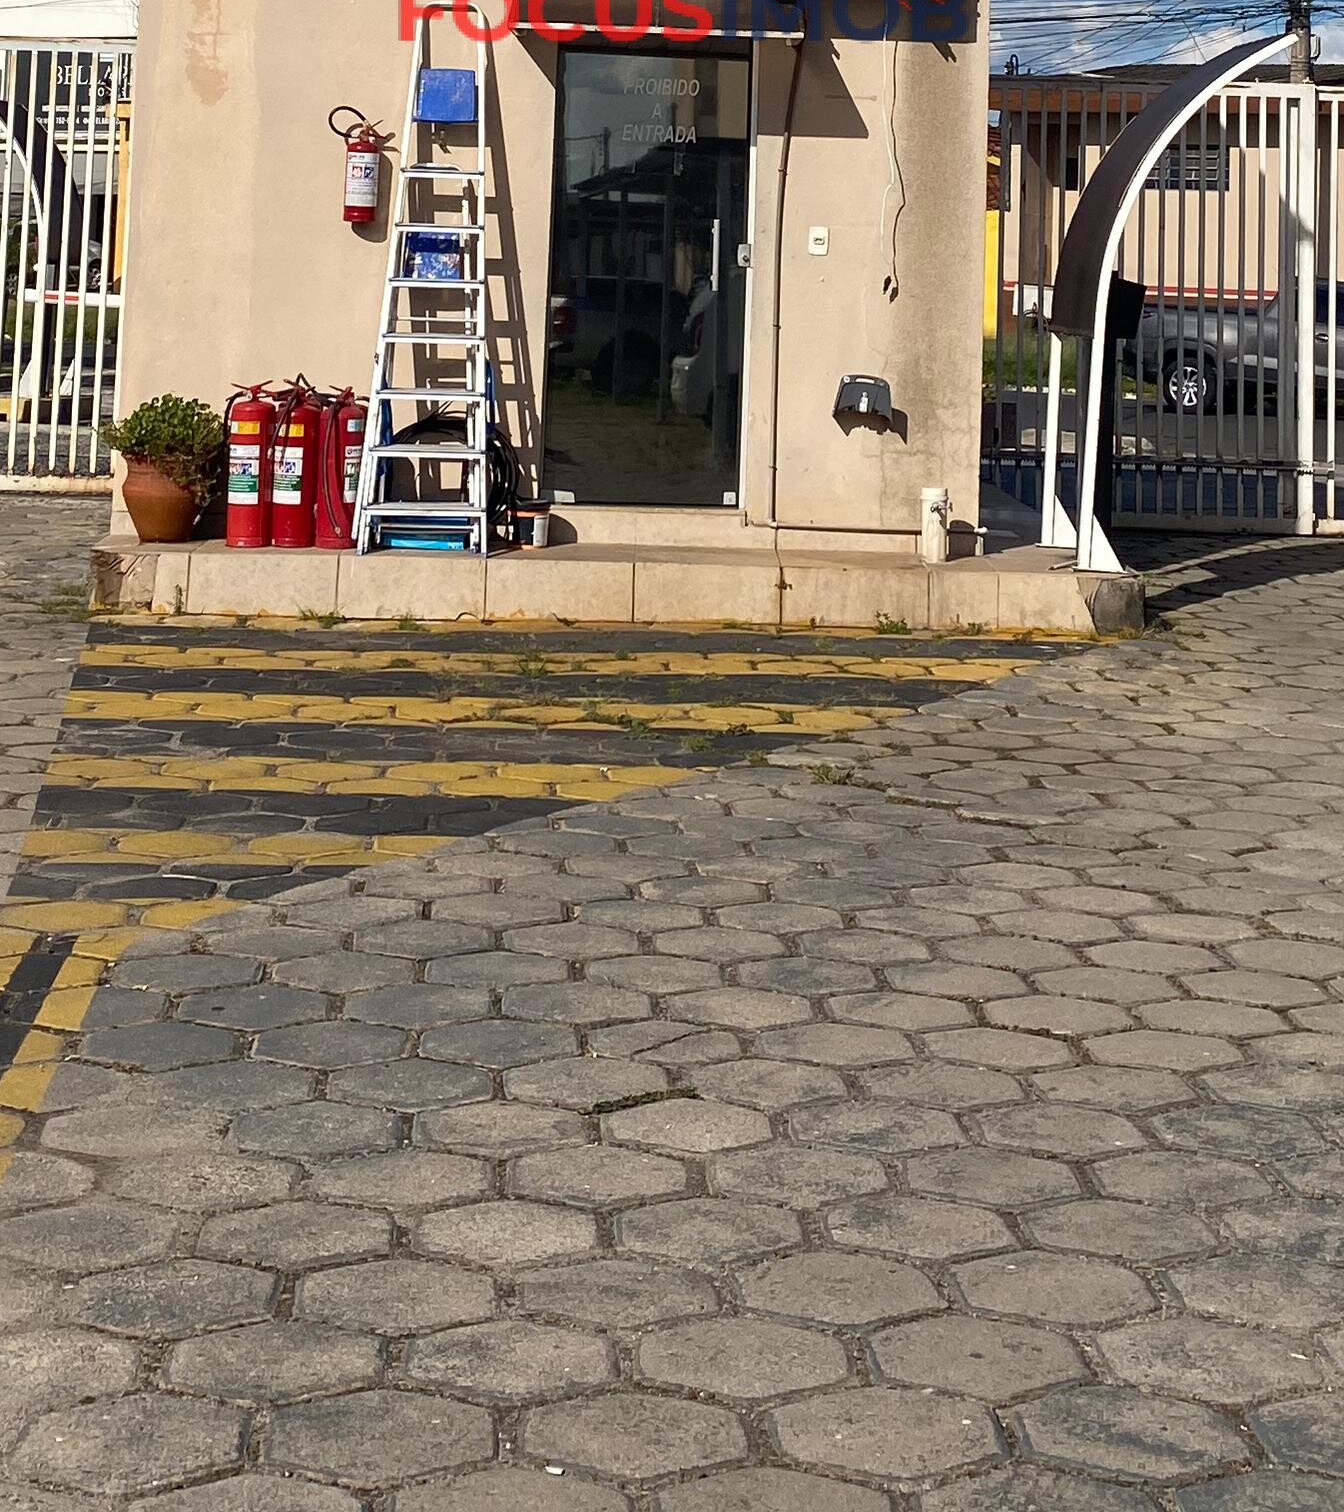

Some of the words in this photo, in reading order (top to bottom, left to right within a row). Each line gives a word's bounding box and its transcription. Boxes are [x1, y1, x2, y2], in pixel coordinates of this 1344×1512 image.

[623, 78, 700, 97] PROIBIDO
[651, 102, 662, 119] A
[622, 123, 697, 144] ENTRADA
